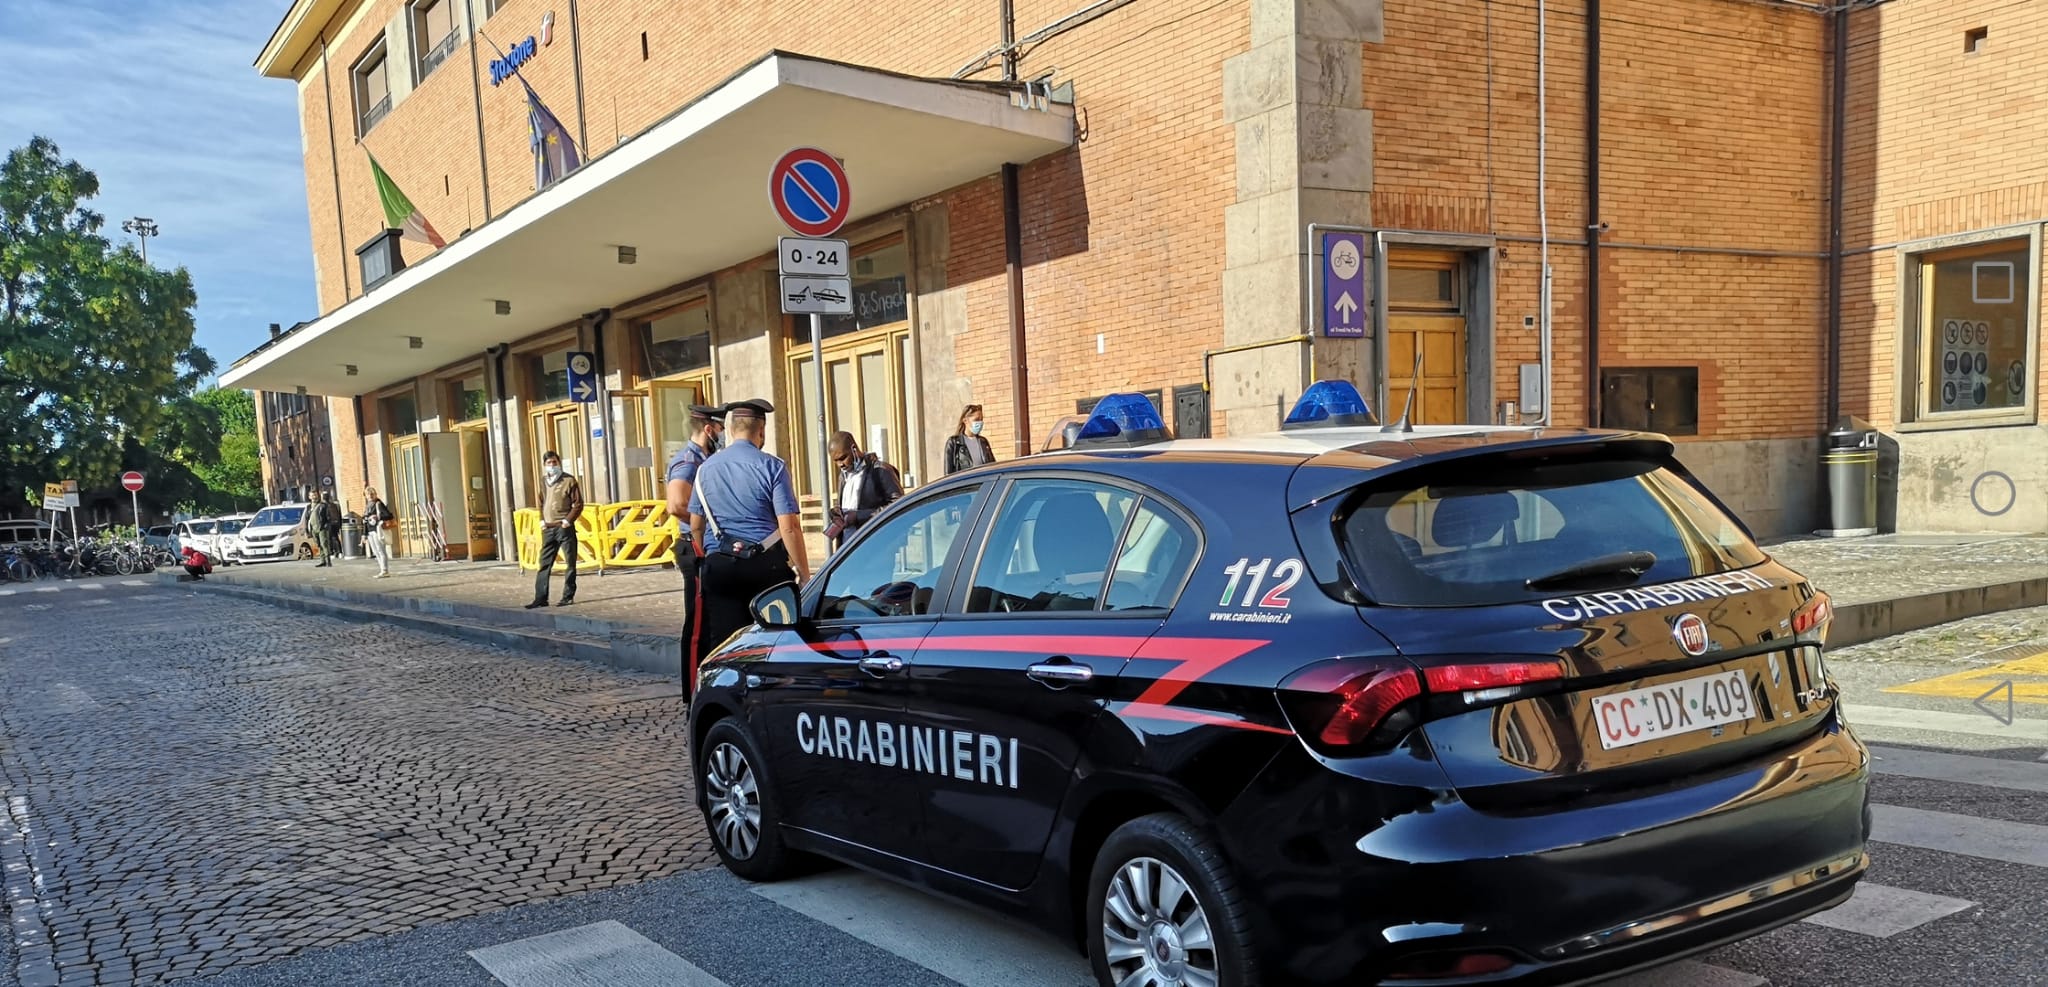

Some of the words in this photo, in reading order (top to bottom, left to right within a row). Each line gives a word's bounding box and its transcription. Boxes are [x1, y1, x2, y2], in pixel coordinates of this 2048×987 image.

[791, 249, 802, 264] 0
[816, 250, 839, 266] 24
[870, 280, 906, 313] Snack
[1219, 557, 1304, 609] 112
[1542, 568, 1774, 623] CARABINIERI
[1208, 611, 1292, 624] www.carabinieri.it
[1682, 624, 1703, 646] FIAT
[796, 711, 1019, 790] CARABINIERI
